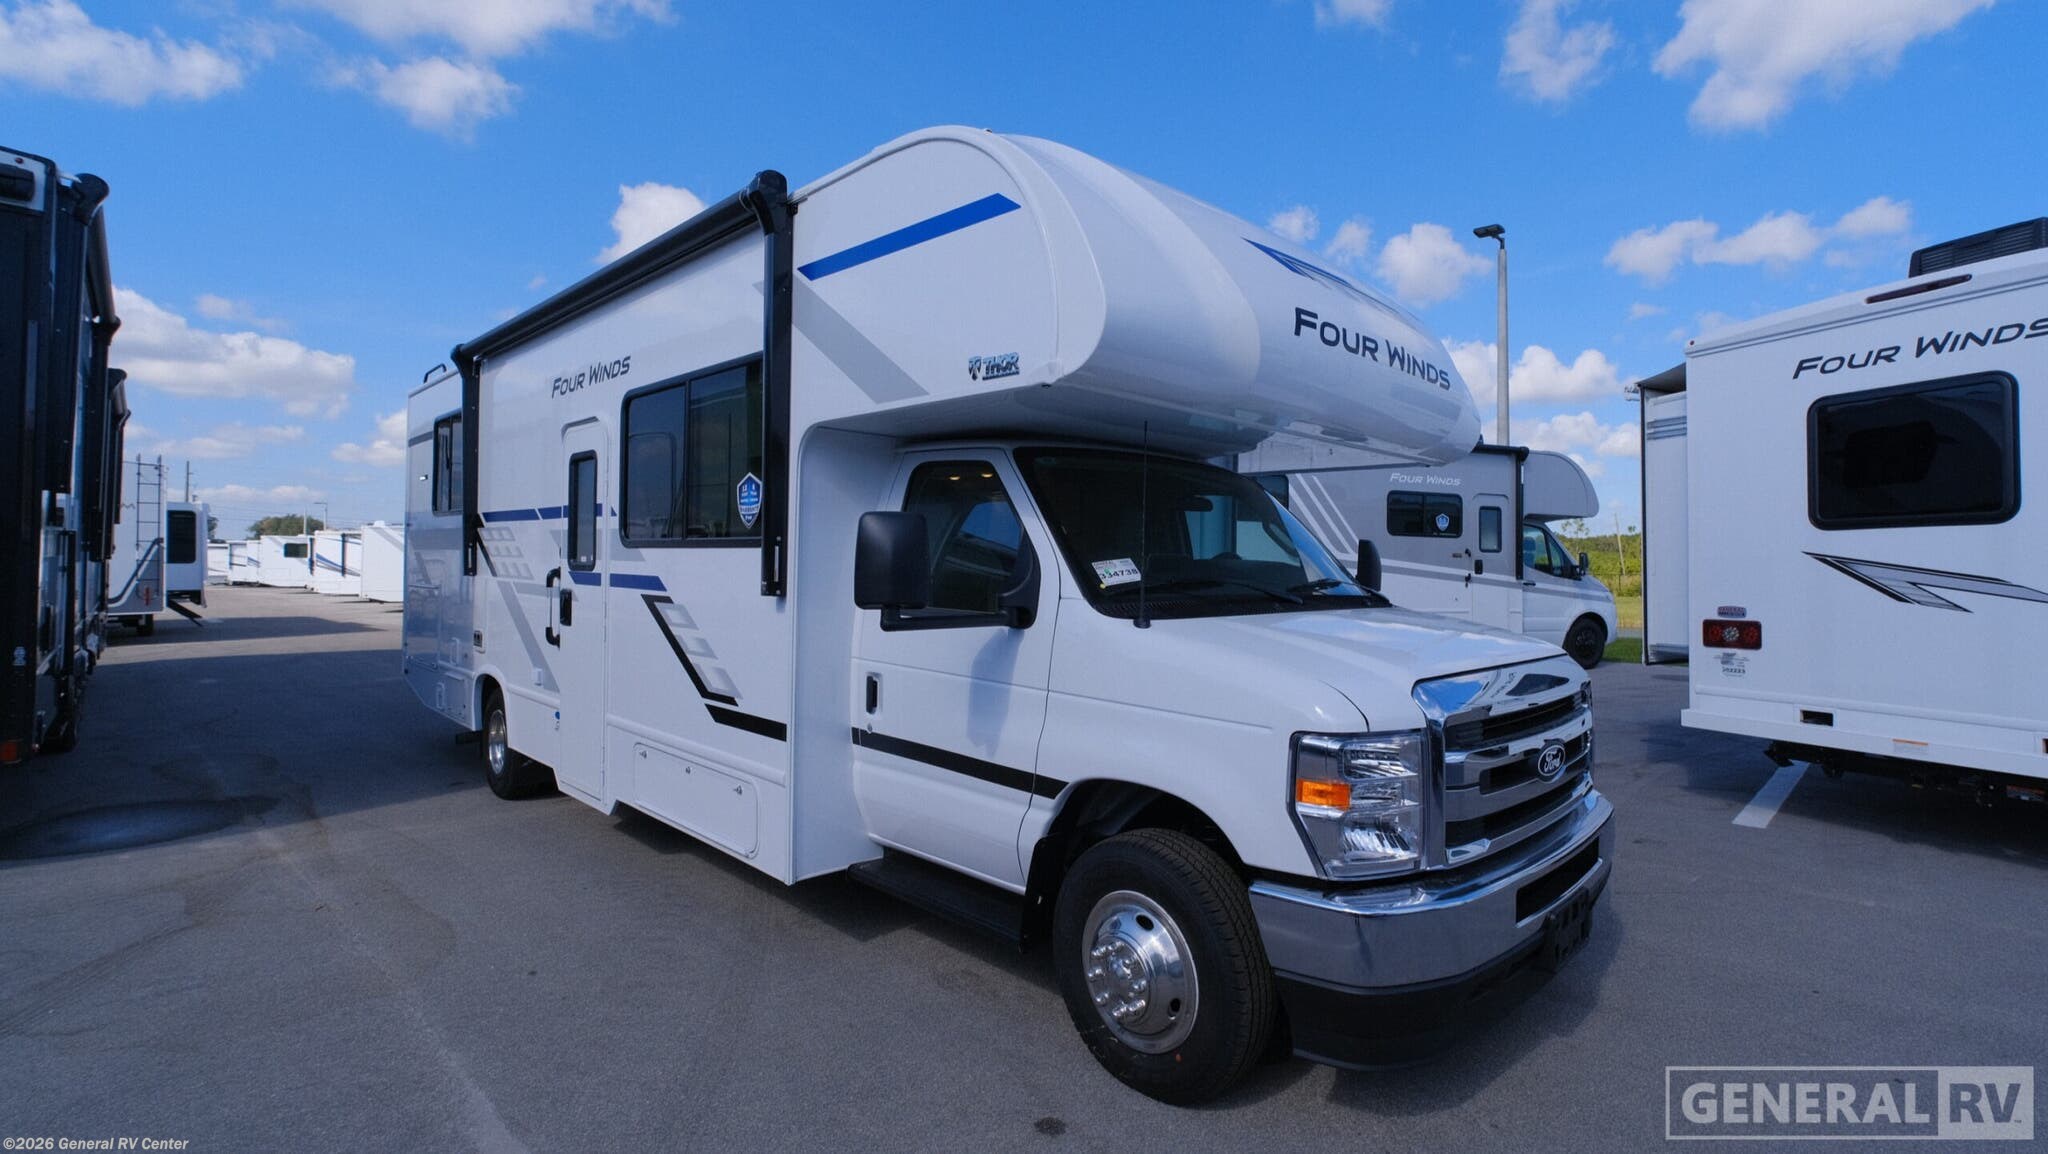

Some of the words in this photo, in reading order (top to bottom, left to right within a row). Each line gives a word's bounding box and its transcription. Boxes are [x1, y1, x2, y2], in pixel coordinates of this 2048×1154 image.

[982, 351, 1020, 376] THOR
[1294, 307, 1379, 362] FOUR
[1385, 339, 1450, 391] WINDS
[1792, 345, 1901, 380] FOUR
[551, 372, 586, 399] FOUR
[588, 355, 631, 386] WINDS
[1390, 472, 1424, 484] FOUR
[1426, 474, 1461, 486] WINDS
[1544, 748, 1562, 772] Ford
